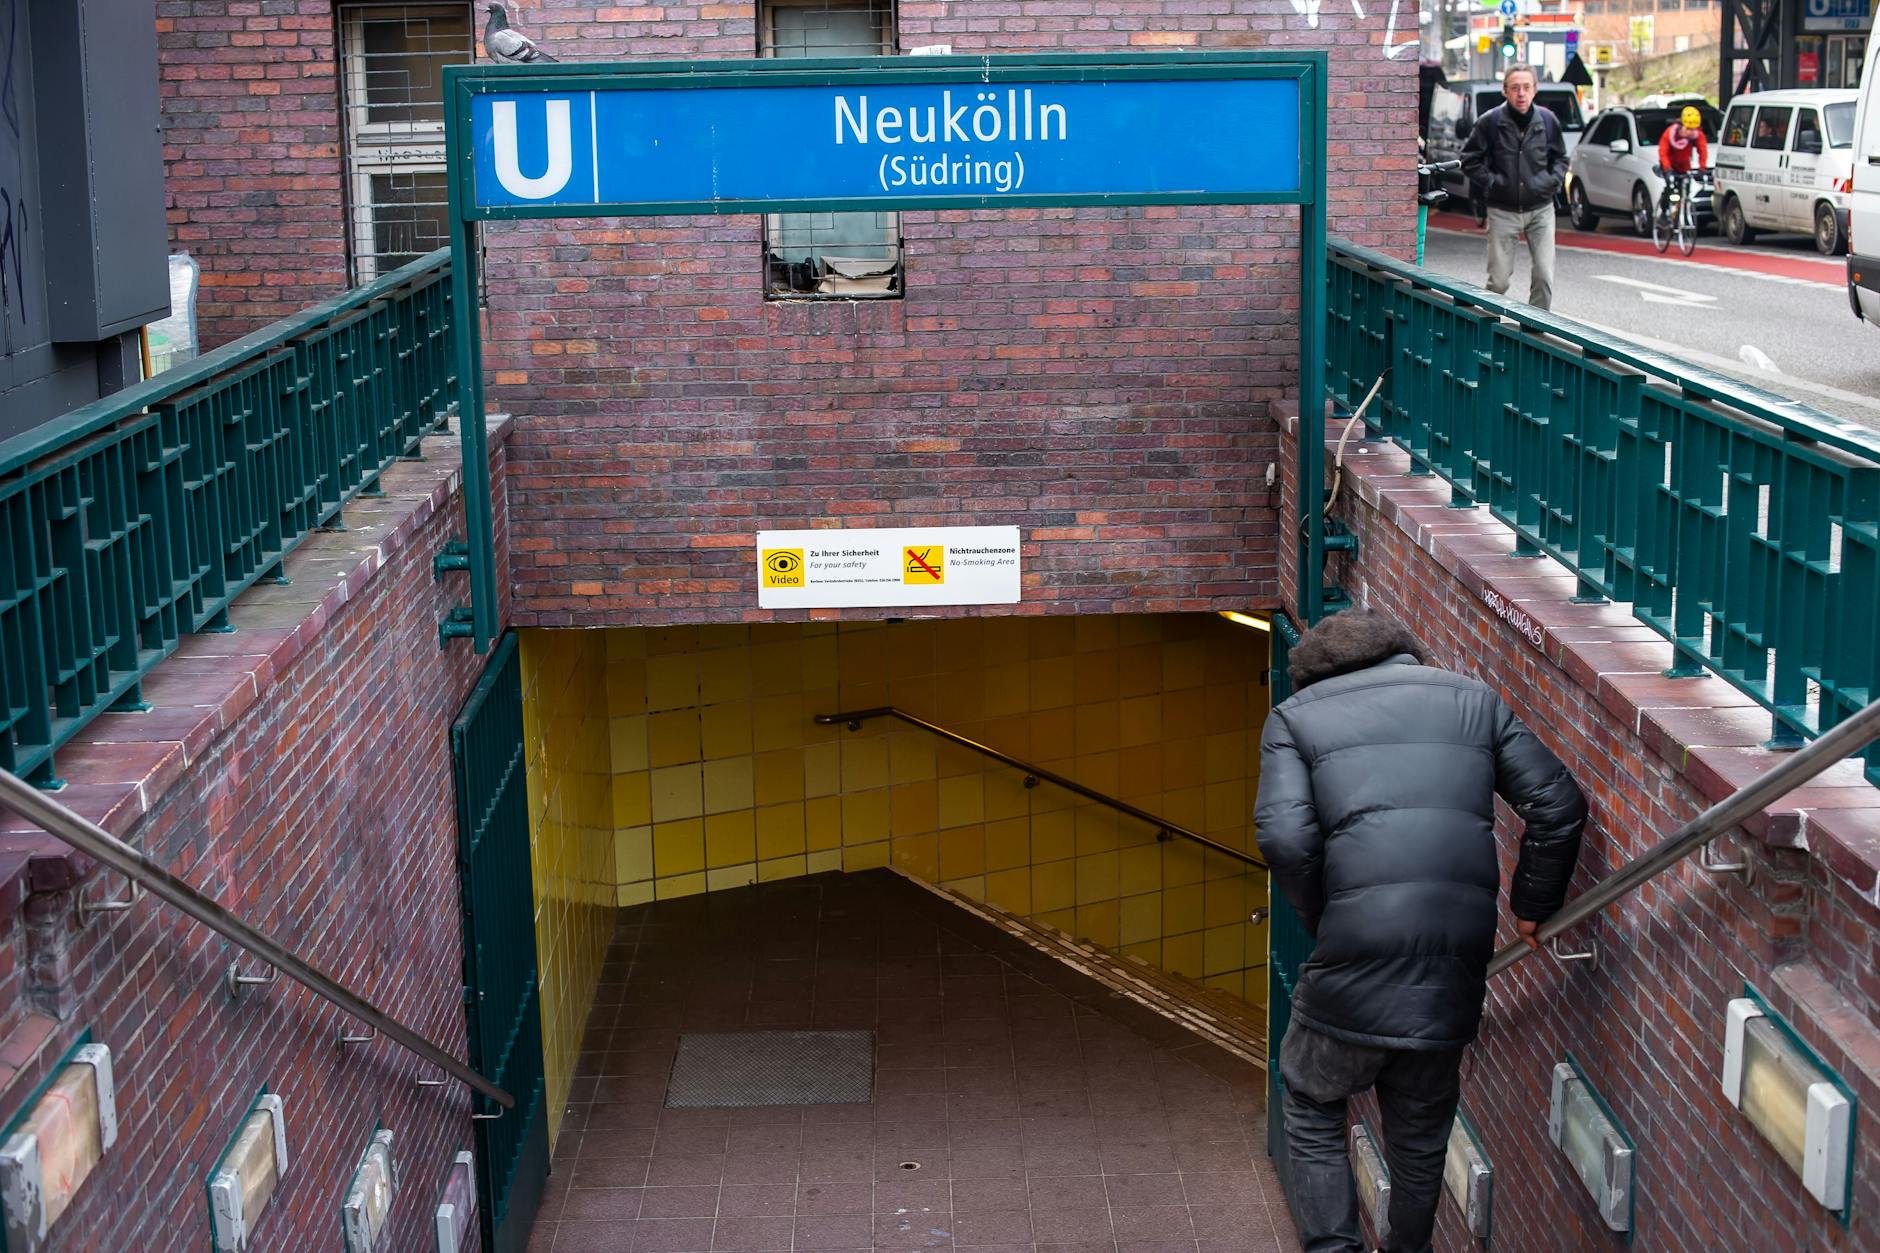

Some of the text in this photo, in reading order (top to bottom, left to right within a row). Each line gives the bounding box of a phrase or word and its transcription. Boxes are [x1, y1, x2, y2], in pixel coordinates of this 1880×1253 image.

[834, 88, 1067, 145] Neukölln
[492, 99, 572, 200] U
[878, 151, 1025, 192] (Südring)
[842, 549, 880, 557] Sicherheit
[810, 561, 822, 569] For
[843, 561, 867, 570] safety
[949, 559, 995, 567] No-Smoking
[770, 575, 799, 584] Video
